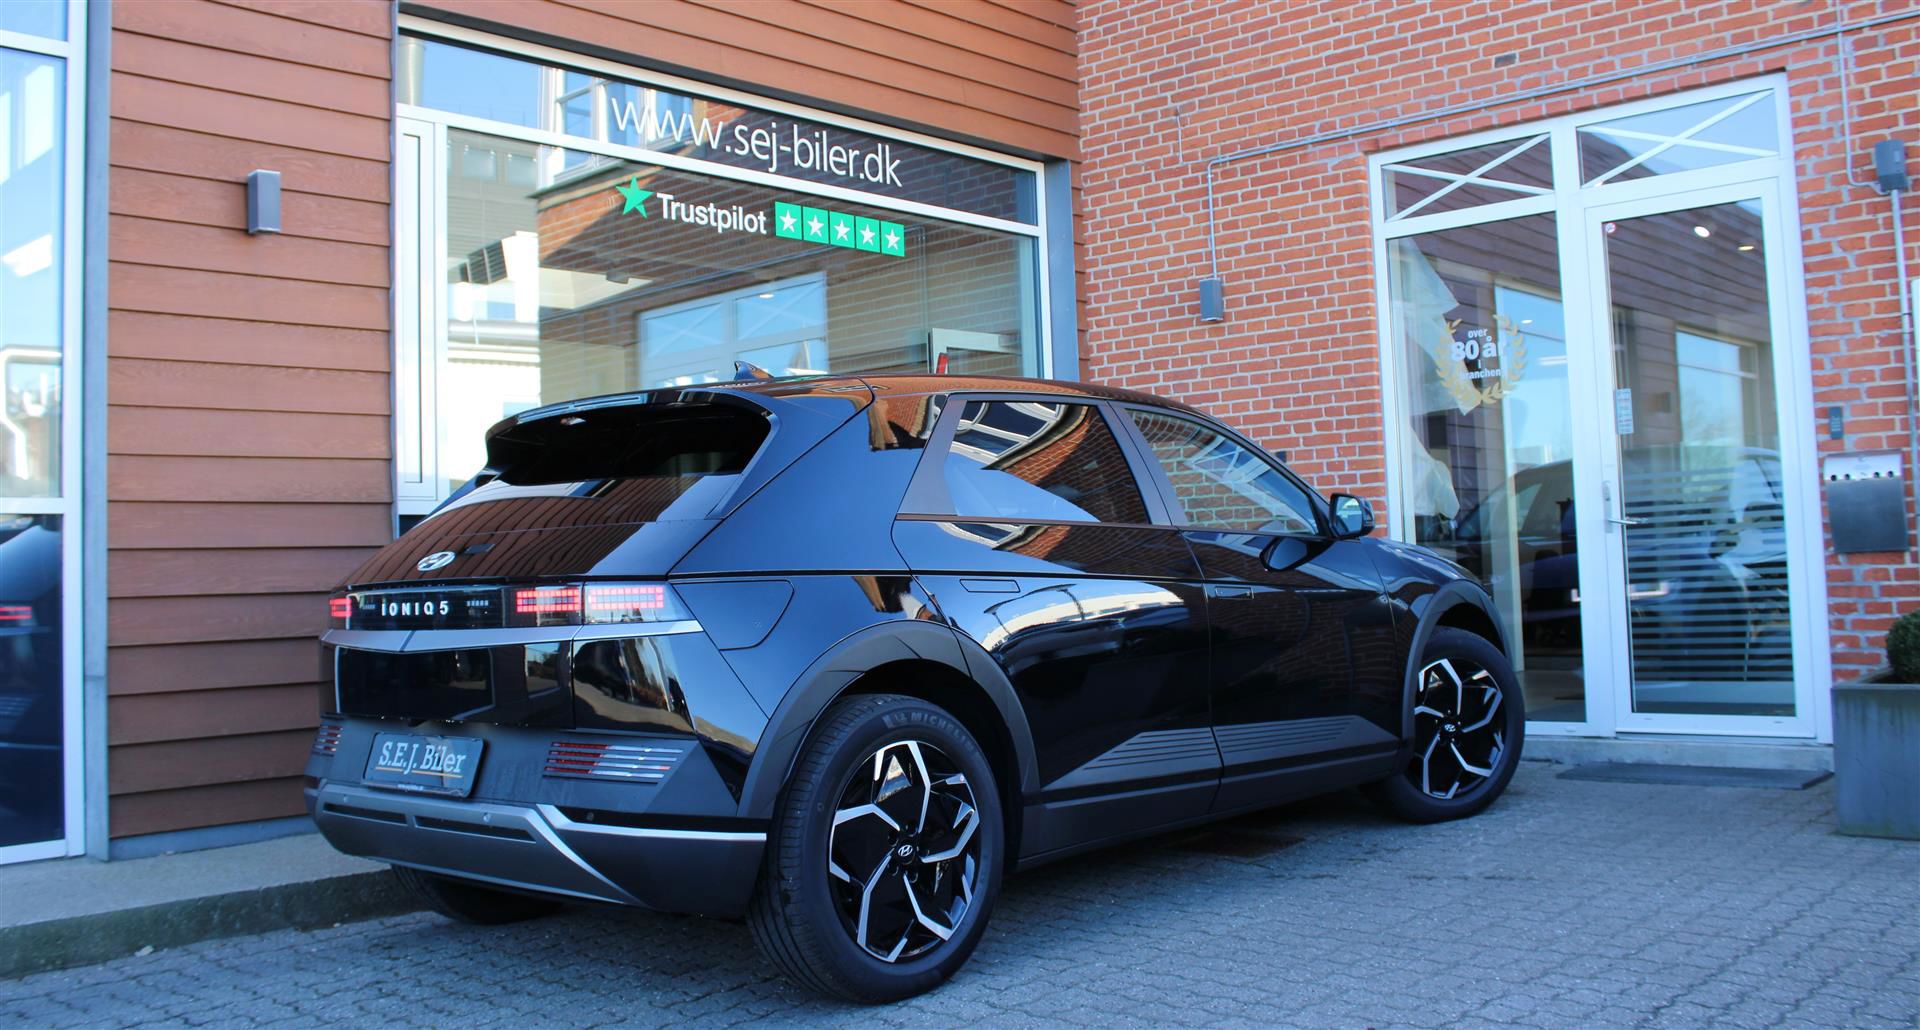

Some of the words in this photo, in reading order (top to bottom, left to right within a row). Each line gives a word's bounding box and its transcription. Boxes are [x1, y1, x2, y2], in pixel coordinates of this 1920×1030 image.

[611, 97, 902, 187] www.sej-biler.dk
[656, 192, 767, 235] Trustpilot
[1467, 328, 1488, 339] over
[1451, 339, 1479, 361] 80
[381, 601, 435, 617] IONIQ
[439, 600, 449, 615] 5
[378, 740, 418, 775] S.E.J.
[420, 744, 467, 774] Biler
